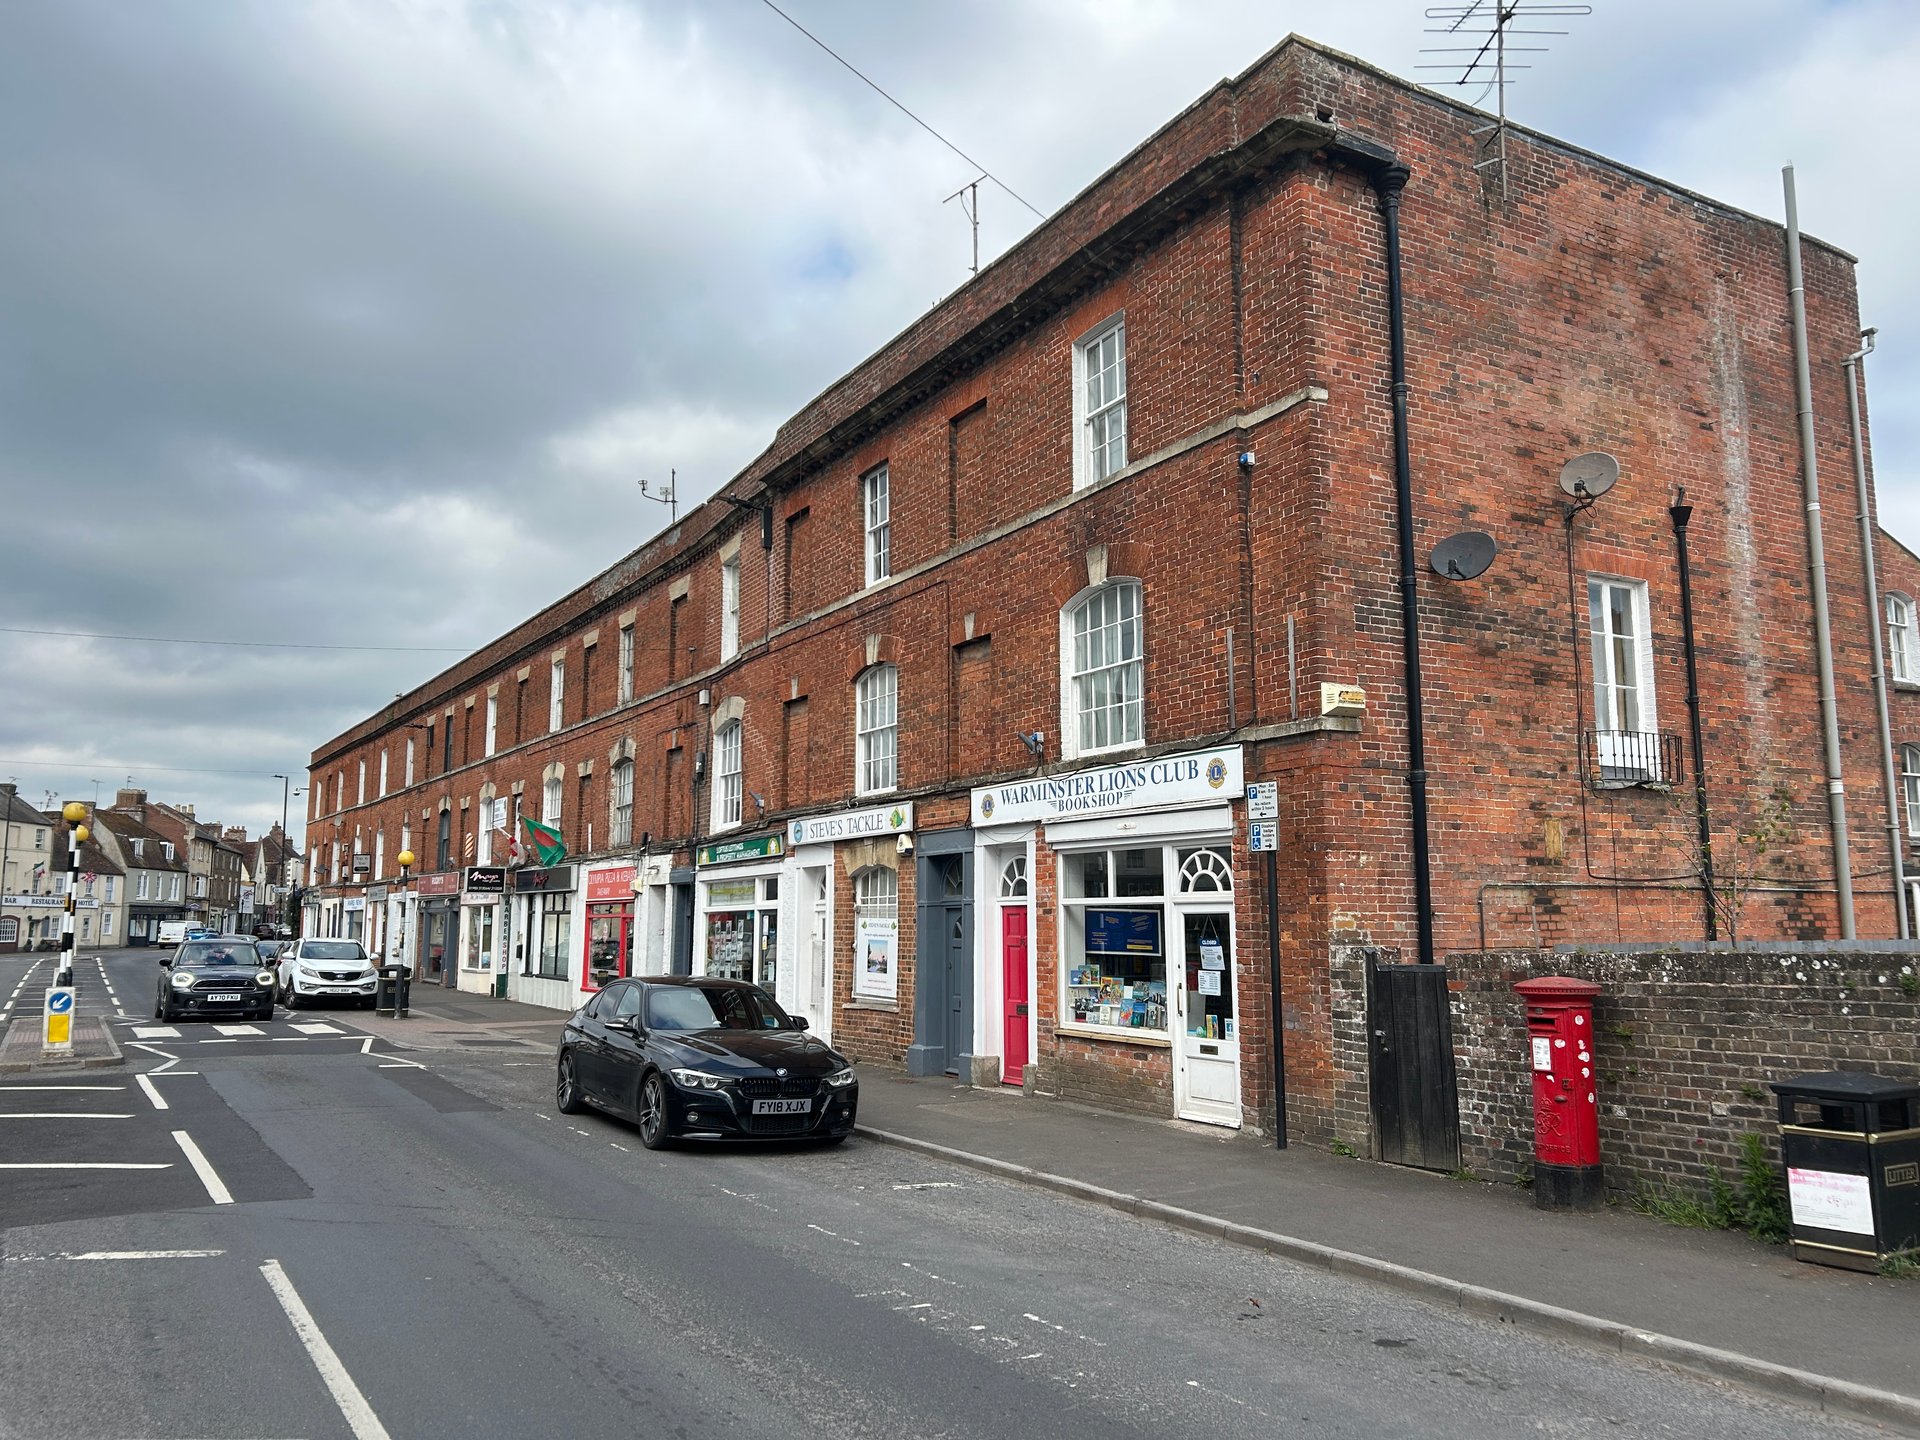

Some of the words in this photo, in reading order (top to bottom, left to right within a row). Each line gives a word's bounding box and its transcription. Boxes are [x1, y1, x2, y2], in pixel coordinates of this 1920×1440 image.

[1000, 775, 1095, 806] WARMINSTER
[1099, 766, 1146, 793] LIONS
[1150, 759, 1199, 785] CLUB
[1058, 791, 1123, 812] BOOKSHOP
[810, 819, 843, 839] STEVE'S
[847, 813, 884, 834] TACKLE
[759, 1101, 783, 1113] FY18
[785, 1100, 806, 1112] XJX
[1888, 1168, 1916, 1182] LITTER
